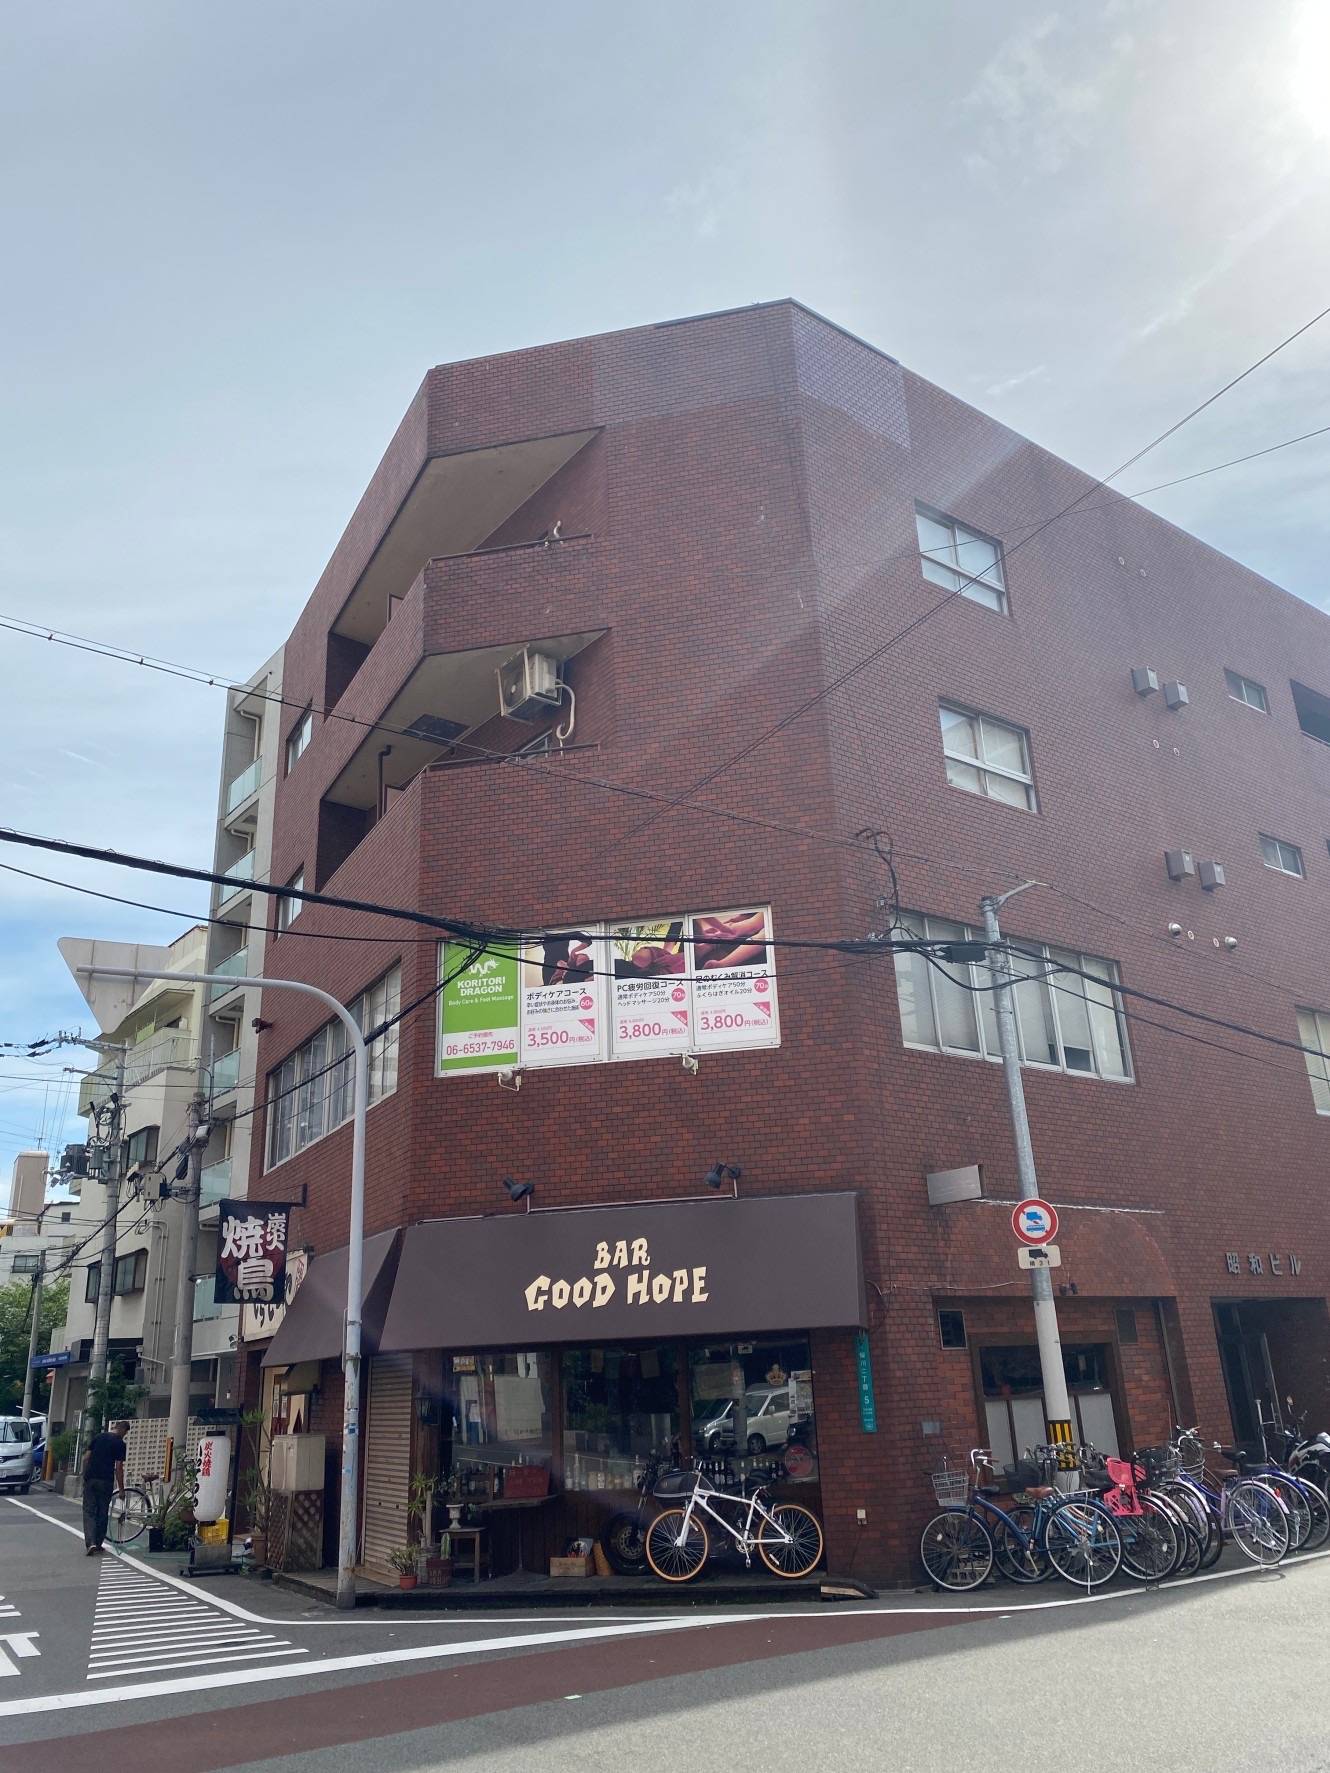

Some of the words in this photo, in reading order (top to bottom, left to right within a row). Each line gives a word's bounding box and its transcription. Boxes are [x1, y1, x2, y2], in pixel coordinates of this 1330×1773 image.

[457, 976, 505, 989] KORITORI
[617, 980, 684, 993] PC疲労回復コース
[460, 985, 502, 997] DRAGON
[526, 988, 588, 1000] ボディケアコース
[448, 999, 461, 1007] Body
[617, 997, 670, 1007] ヘッドマッサージ20分
[446, 1039, 515, 1056] 06-6537-7946
[221, 1215, 275, 1302] 焼鳥
[594, 1237, 650, 1269] BAR
[1225, 1252, 1302, 1276] 昭和ビル
[524, 1272, 616, 1311] GOOD
[626, 1266, 710, 1305] HOPE
